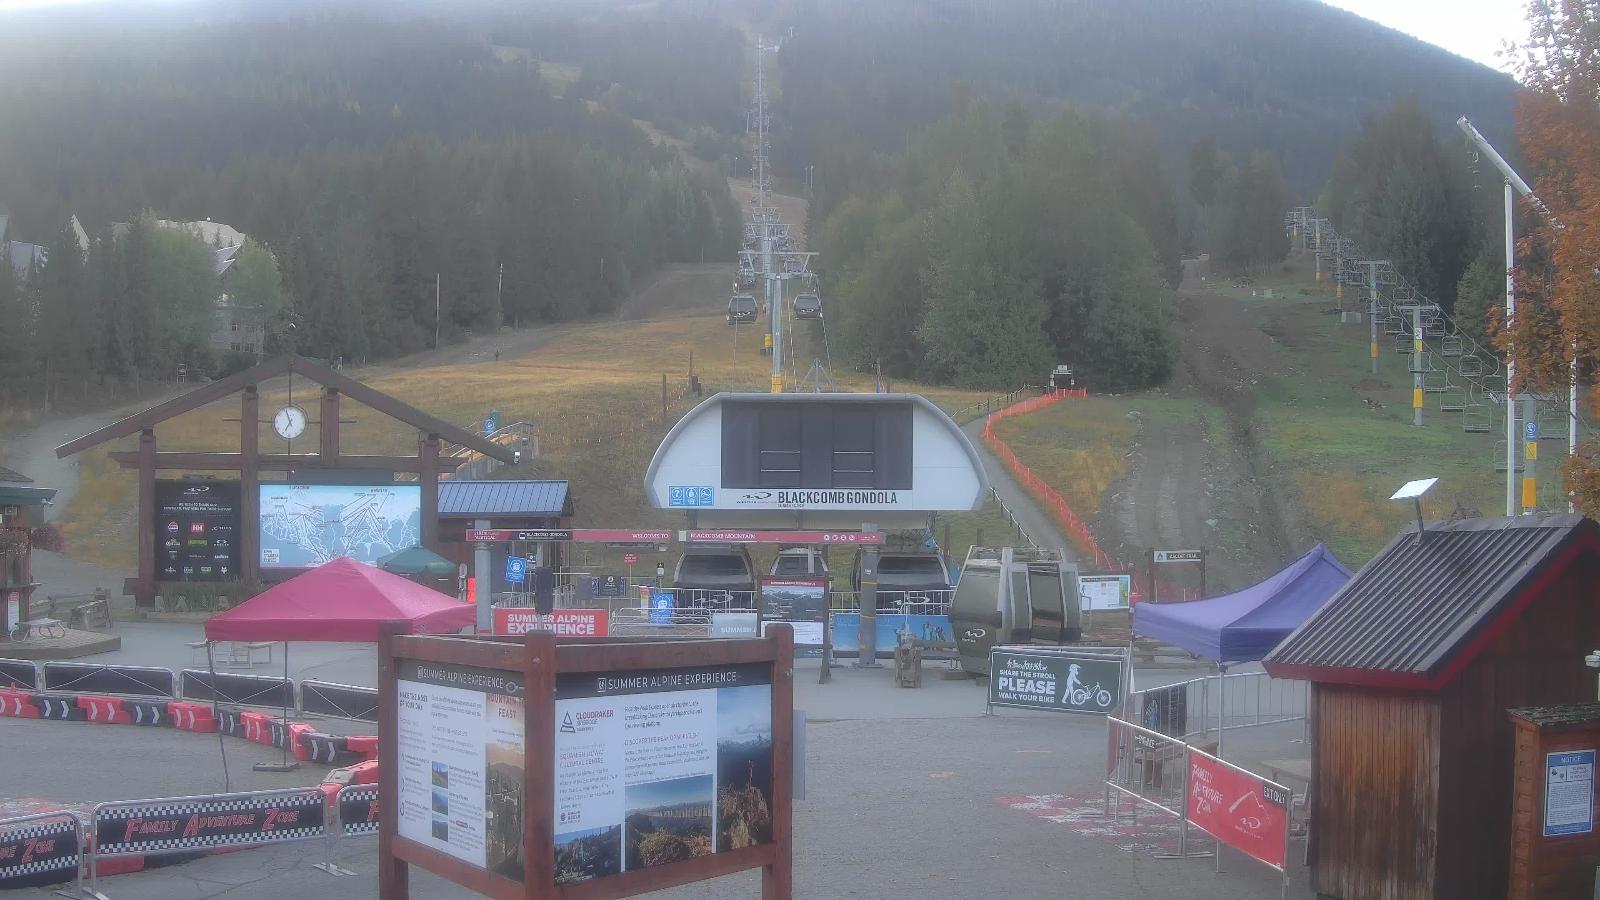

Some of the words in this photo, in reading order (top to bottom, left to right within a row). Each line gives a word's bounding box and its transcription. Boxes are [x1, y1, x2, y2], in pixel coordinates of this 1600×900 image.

[778, 491, 845, 504] BLACKCOMB
[846, 491, 898, 504] GONDOLA
[557, 614, 595, 624] ALPINE
[423, 668, 446, 681] SUMMER
[446, 671, 468, 684] ALPINE
[468, 674, 504, 689] EXPERIENCE
[608, 676, 648, 690] SUMMER
[650, 674, 683, 688] ALPINE
[685, 671, 737, 685] EXPERIENCE
[1000, 669, 1019, 677] SHARE
[1032, 672, 1056, 680] STROLL
[999, 676, 1056, 695] PLEASE
[998, 691, 1018, 700] WALK
[1018, 694, 1038, 702] YOUR
[1038, 695, 1055, 703] BIKE
[498, 708, 517, 719] FEAST
[576, 709, 614, 720] CLOUDRAKER
[1560, 755, 1582, 763] NOTICE
[124, 818, 179, 842] FAMILY
[182, 813, 256, 838] ADVENTURE
[262, 808, 300, 831] ZONE
[21, 837, 56, 864] ZONE
